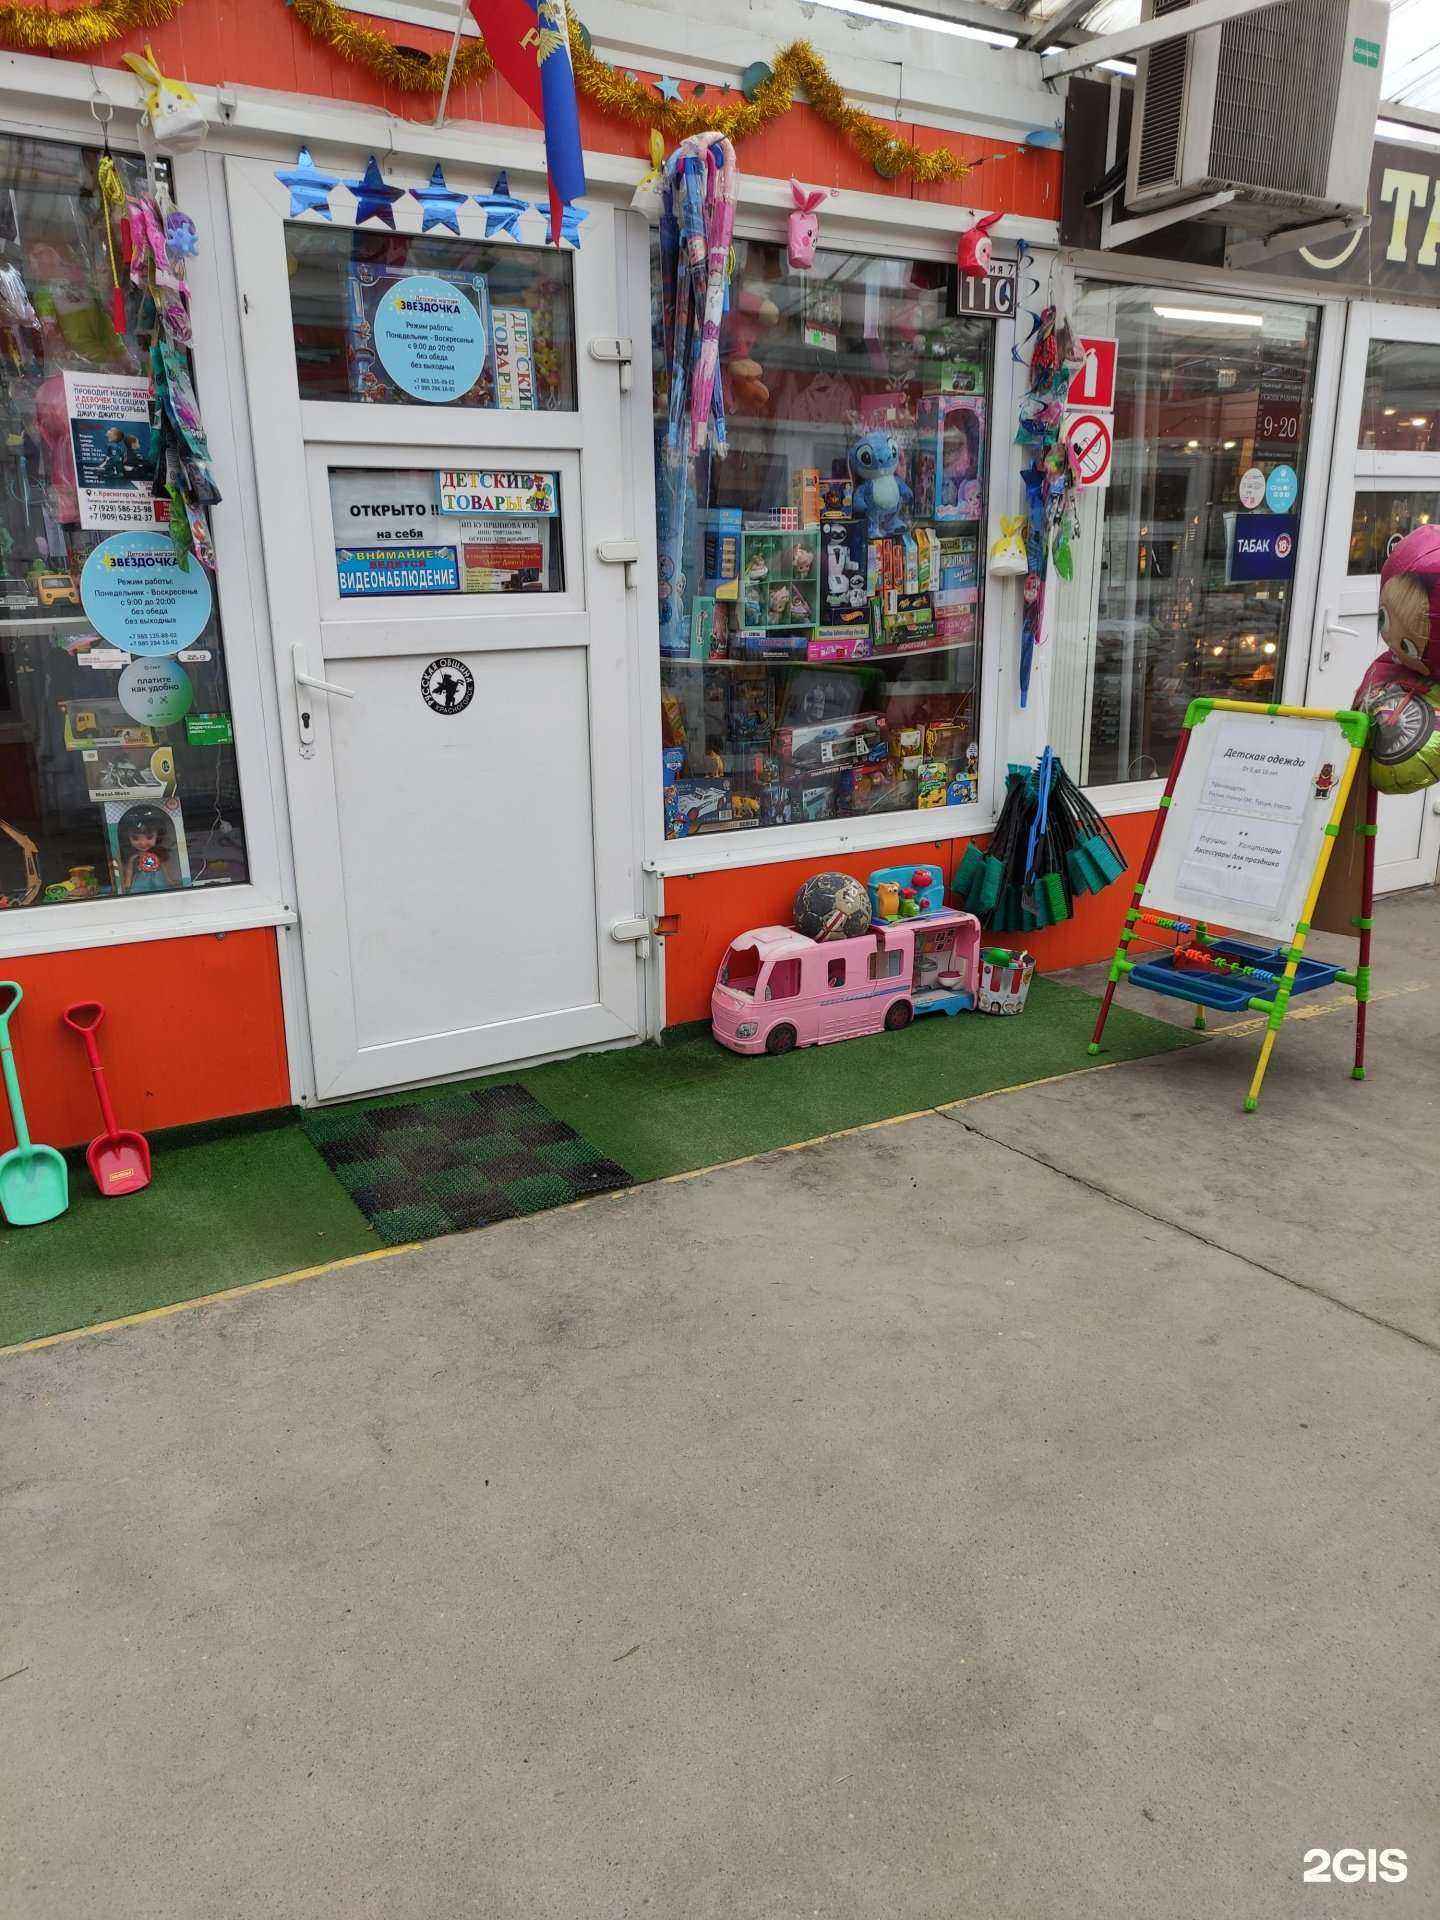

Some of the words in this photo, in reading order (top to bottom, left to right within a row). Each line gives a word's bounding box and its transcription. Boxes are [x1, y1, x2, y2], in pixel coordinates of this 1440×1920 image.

[1008, 264, 1014, 274] 7
[400, 301, 460, 314] ЗВЕЗДОЧКА
[406, 321, 428, 330] Режим
[386, 331, 428, 340] Понедельник
[438, 344, 455, 352] 20:00
[442, 472, 532, 490] ДЕТСКИЕ
[444, 495, 522, 511] ТОВАРЫ
[99, 504, 116, 513] (929)
[350, 504, 426, 517] ОТКРЫТО
[89, 513, 98, 521] +7
[377, 531, 392, 539] на
[395, 529, 424, 539] себя
[1237, 539, 1270, 552] ТАБАК
[340, 569, 455, 592] ВИДЕОНАБЛЮДЕНИЕ
[94, 589, 144, 598] Понедельник
[151, 588, 198, 596] Воскресенье
[146, 608, 168, 616] обеда
[440, 659, 472, 683] ОБЩИНА
[137, 677, 171, 685] платите
[421, 662, 438, 706] РУССКАЯ
[148, 684, 179, 693] удобно
[1224, 748, 1266, 762] Детская
[1267, 754, 1305, 767] одежда
